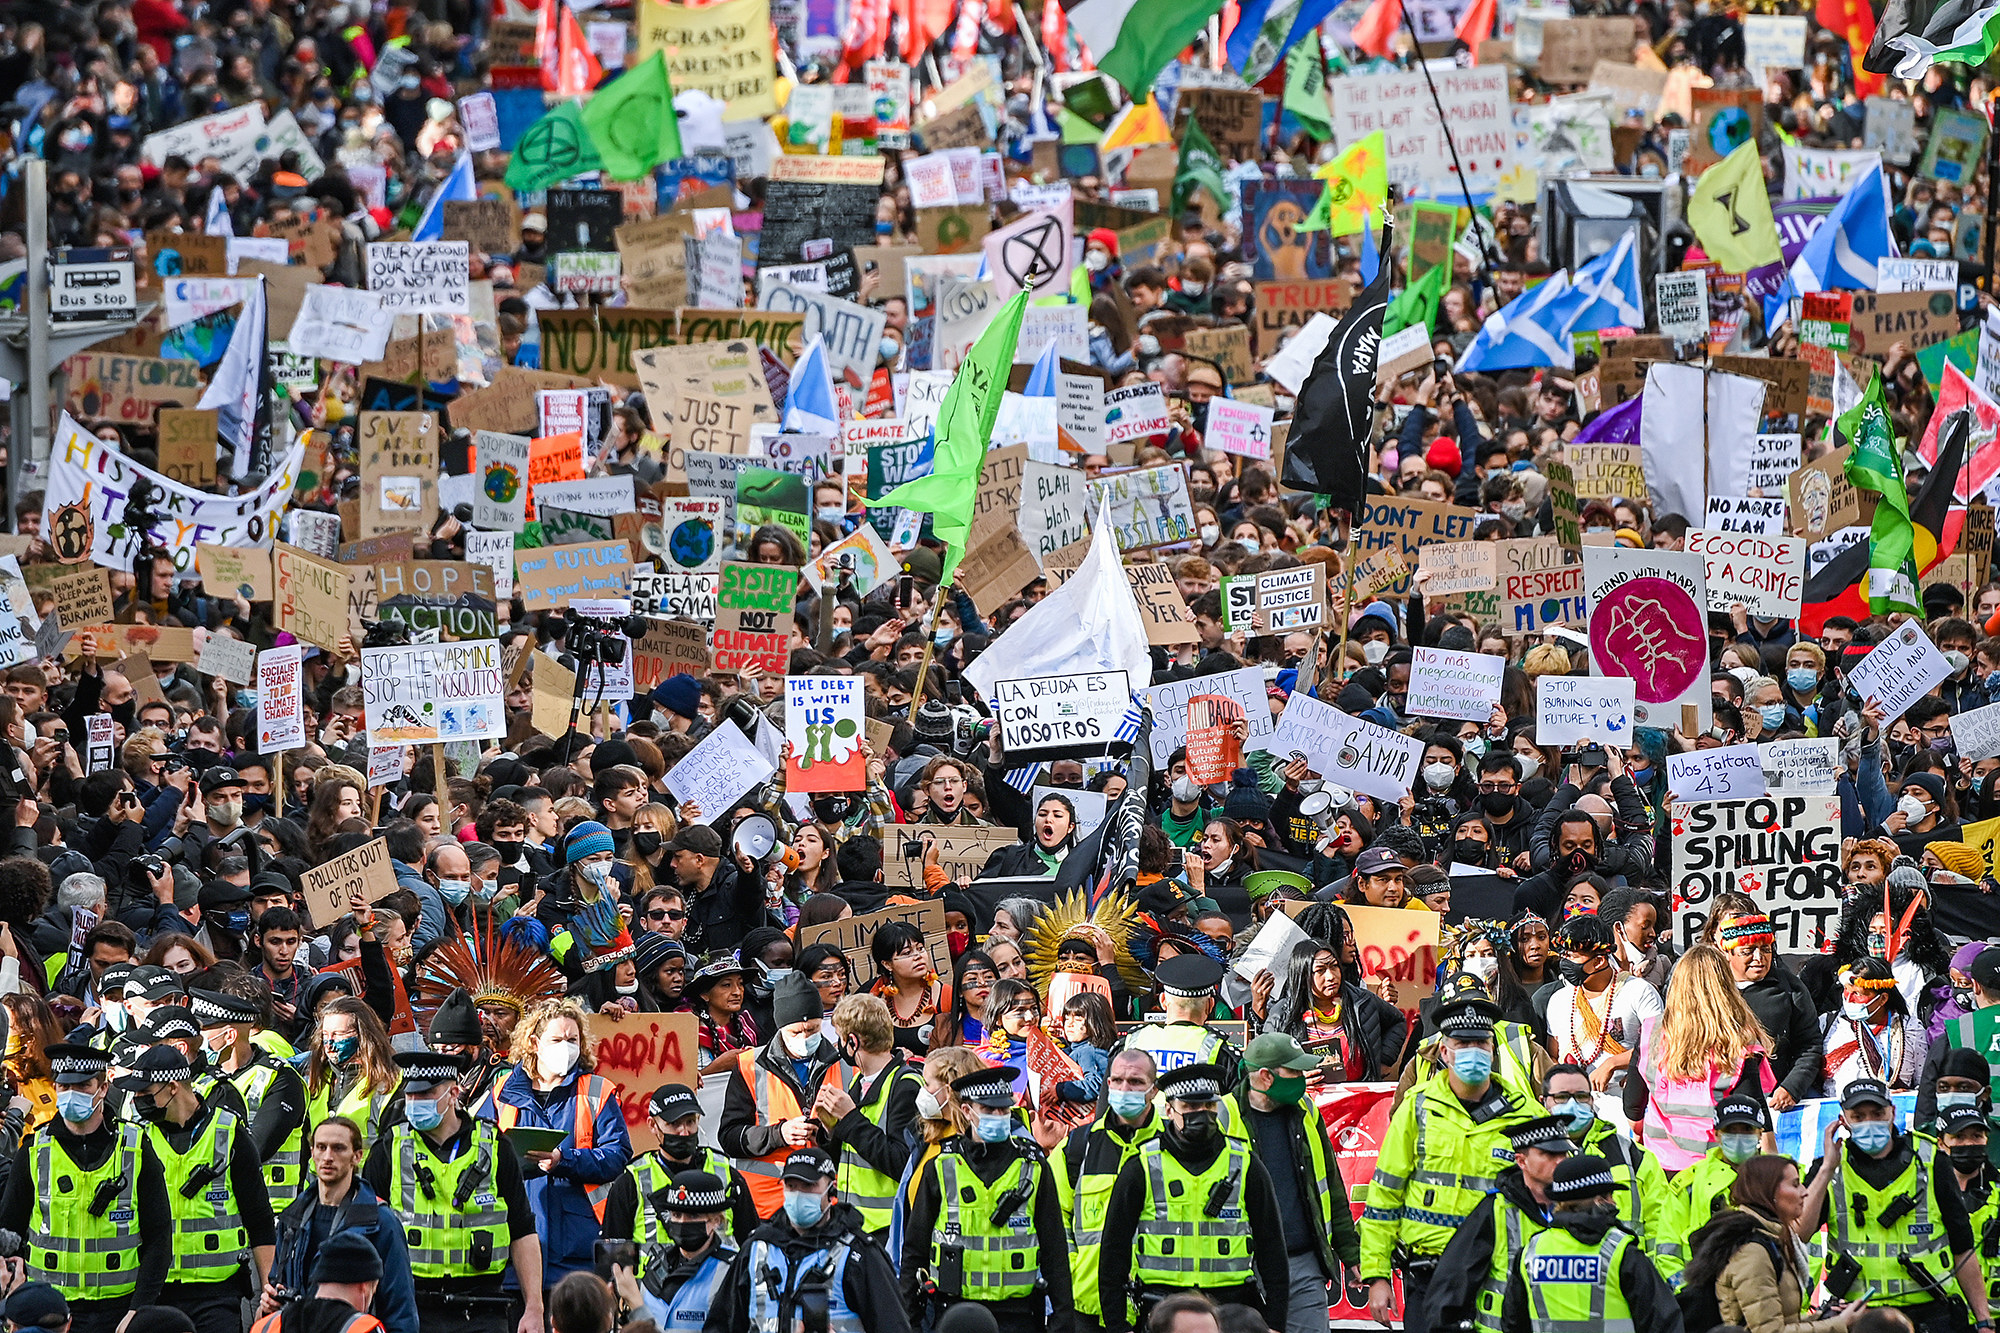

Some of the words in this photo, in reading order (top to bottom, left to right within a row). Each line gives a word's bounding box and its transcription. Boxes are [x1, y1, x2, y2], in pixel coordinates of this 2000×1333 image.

[651, 24, 745, 44] #GRAND
[1346, 84, 1370, 103] THE
[1377, 82, 1404, 99] LAST
[1405, 86, 1419, 98] OF
[1348, 112, 1374, 128] THE
[1378, 109, 1412, 127] LAST
[1425, 103, 1497, 122] SAMURAI
[1389, 136, 1426, 155] LAST
[1438, 129, 1506, 155] HUMAN
[1796, 155, 1851, 181] Help
[371, 245, 422, 259] EVERY
[374, 261, 406, 275] OUR
[412, 260, 467, 274] LEADERS
[559, 255, 616, 271] PLANET
[372, 276, 396, 290] DO
[403, 275, 434, 288] NOT
[559, 276, 618, 292] PROFIT
[1659, 281, 1697, 292] SYSTEM
[60, 294, 86, 306] Bus
[94, 293, 127, 306] Stop
[411, 294, 440, 306] FAIL
[450, 293, 465, 305] US
[1262, 284, 1340, 307] TRUE
[1660, 290, 1698, 300] CHANGE
[1960, 286, 1976, 310] P
[1026, 312, 1076, 323] PLANET
[1660, 307, 1701, 316] CLIMATE
[1875, 310, 1928, 334] PEATS
[541, 319, 598, 374] NO
[1352, 326, 1380, 375] MAPA
[100, 359, 135, 383] LET
[1070, 381, 1093, 391] haven't
[550, 405, 577, 415] GLOBAL
[1061, 403, 1077, 412] polar
[1079, 403, 1094, 411] bear
[547, 416, 582, 426] WARMING
[1087, 425, 1097, 433] to!
[848, 427, 905, 441] CLIMATE
[1758, 440, 1794, 452] STOP
[1571, 448, 1630, 463] DEFEND
[1038, 475, 1070, 500] BLAH
[1709, 497, 1730, 514] NO
[1736, 499, 1782, 516] MORE
[1433, 514, 1473, 538] LET
[1721, 517, 1766, 534] BLAH
[467, 535, 512, 552] CHANGE
[1432, 544, 1459, 555] PHASE
[1462, 542, 1478, 552] OUT
[1689, 533, 1794, 565] ECOCIDE
[521, 559, 547, 573] our
[553, 545, 628, 571] FUTURE
[381, 567, 489, 596] HOPE
[724, 564, 798, 591] SYSTEM
[1261, 571, 1313, 589] CLIMATE
[1373, 567, 1387, 581] NOT
[1432, 570, 1459, 580] PHASE
[1462, 567, 1478, 578] OUT
[54, 583, 74, 594] HOW
[77, 578, 86, 586] DO
[89, 574, 100, 583] WE
[526, 584, 540, 598] in
[545, 582, 578, 603] your
[633, 576, 711, 597] IRELAND
[1507, 569, 1581, 600] RESPECT
[1592, 571, 1630, 603] STAND
[1632, 567, 1660, 580] WITH
[1666, 570, 1697, 597] MAPA
[58, 589, 82, 603] SLEEP
[83, 584, 103, 595] WHEN
[719, 588, 796, 613] CHANGE
[1264, 590, 1310, 606] JUSTICE
[58, 603, 72, 613] OUR
[76, 597, 98, 608] HOME
[100, 594, 107, 603] IS
[59, 605, 109, 627] BURNING
[279, 602, 337, 640] PERISH
[391, 604, 496, 638] ACTION
[739, 611, 777, 628] NOT
[212, 635, 248, 655] GLOBAL
[713, 630, 789, 654] CLIMATE
[201, 649, 252, 670] WARMING
[363, 652, 399, 680] STOP
[404, 650, 433, 675] THE
[433, 644, 496, 672] WARMING
[1416, 648, 1437, 663] No
[1445, 651, 1471, 670] más
[227, 666, 249, 682] COOL
[260, 661, 299, 678] SOCIALIST
[1417, 666, 1502, 689] negociaciones
[1873, 657, 1897, 681] THE
[265, 673, 295, 687] CHANGE
[364, 677, 401, 705] STOP
[407, 675, 433, 700] THE
[434, 667, 502, 699] MOSQUITOS
[789, 679, 814, 691] THE
[821, 679, 854, 690] DEBT
[1001, 682, 1024, 702] LA
[1030, 678, 1078, 697] DEUDA
[1087, 676, 1107, 692] ES
[1545, 681, 1577, 693] STOP
[1422, 681, 1440, 692] sin
[1444, 683, 1485, 698] escuchar
[263, 698, 296, 712] CLIMATE
[792, 696, 804, 707] IS
[812, 693, 850, 705] WITH
[1409, 692, 1456, 707] nuestras
[1459, 698, 1490, 712] voces
[1543, 697, 1593, 709] BURNING
[1599, 698, 1622, 709] OUR
[264, 707, 295, 721] CHANGE
[1004, 705, 1038, 722] CON
[1007, 718, 1101, 748] NOSOTROS
[1186, 730, 1210, 741] There
[1359, 719, 1409, 747] JUSTICIA
[1187, 737, 1223, 749] climate
[1768, 743, 1829, 759] Cambiemos
[671, 732, 728, 785] IBERDROLA
[692, 746, 732, 782] KILLING
[1189, 754, 1225, 766] without
[1344, 732, 1408, 782] SAMIR
[1789, 752, 1828, 768] sistema
[1191, 761, 1237, 774] indigenous
[1192, 770, 1224, 782] peoples
[1671, 760, 1701, 781] Nos
[1783, 770, 1794, 779] no
[1810, 767, 1834, 778] clima
[1689, 796, 1806, 834] STOP
[1685, 826, 1838, 871] SPILLING
[308, 854, 360, 893] POLLUTERS
[360, 841, 383, 869] OUT
[329, 887, 343, 909] OF
[1849, 1083, 1879, 1093] POLICE
[663, 1092, 692, 1106] POLICE
[1723, 1104, 1753, 1116] POLICE
[1950, 1107, 1979, 1119] POLICE
[787, 1155, 815, 1166] POLICE
[1533, 1257, 1598, 1282] POLICE
